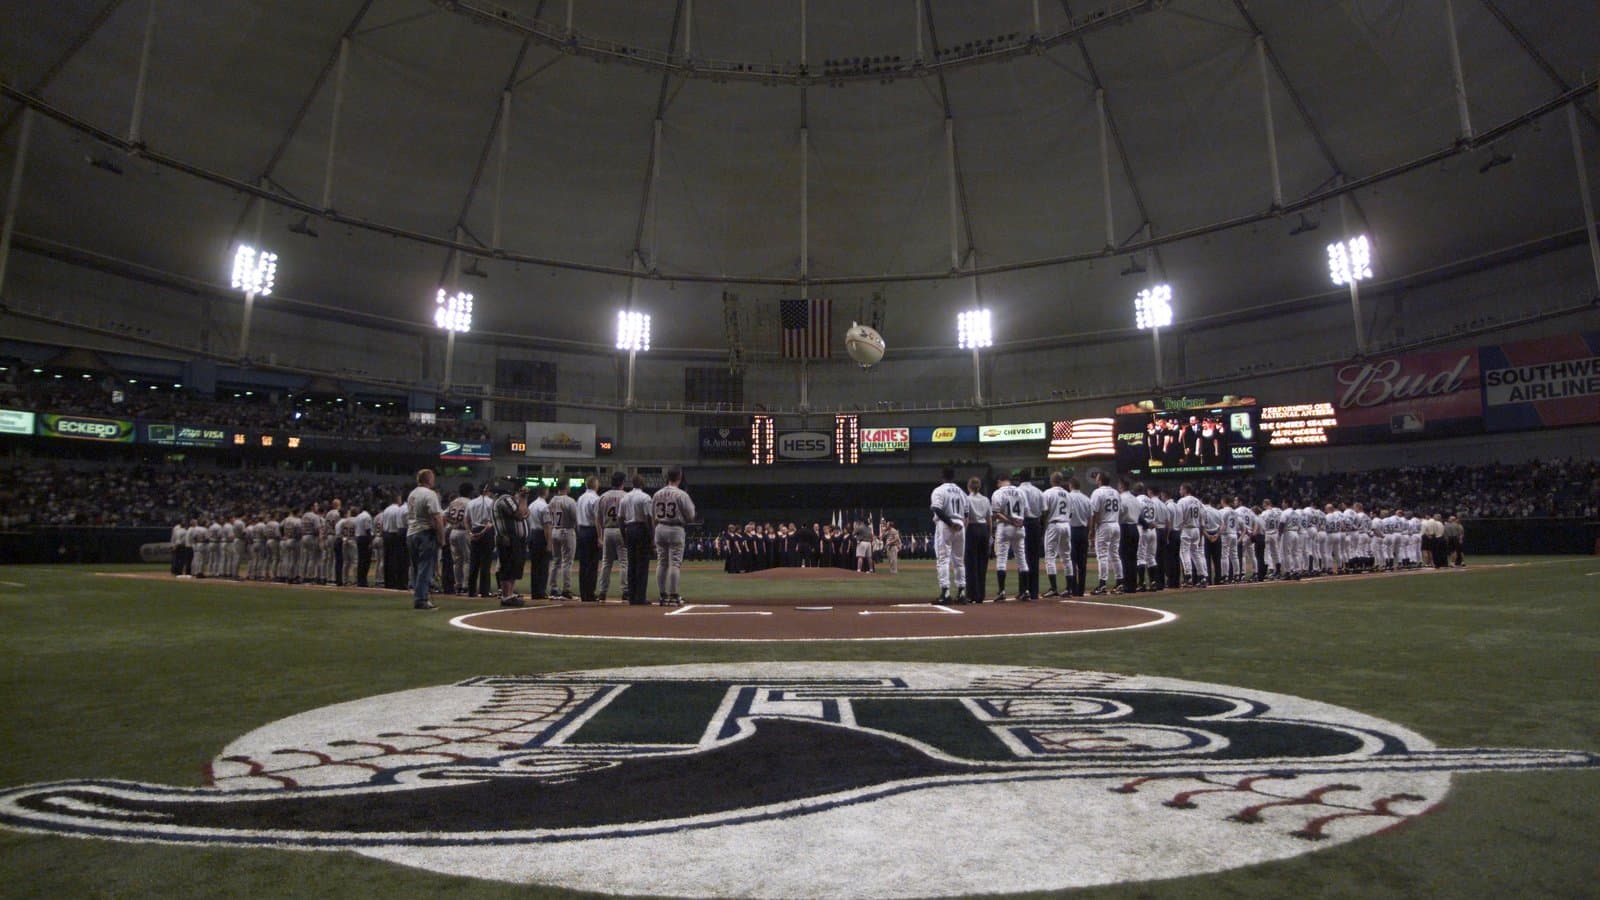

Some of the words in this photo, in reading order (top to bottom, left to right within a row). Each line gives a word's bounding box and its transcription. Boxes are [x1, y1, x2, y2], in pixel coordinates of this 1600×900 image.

[1338, 356, 1469, 409] Bud
[57, 419, 119, 437] ECKERD
[1004, 424, 1042, 436] CHEVROLET
[861, 429, 908, 442] KANE'S
[1117, 432, 1144, 442] PEPSI
[783, 439, 825, 452] HESS
[861, 441, 908, 449] FURNITURE
[656, 502, 676, 519] 33
[951, 498, 960, 513] 11
[1006, 501, 1020, 516] 14
[1058, 501, 1067, 515] 2
[1104, 498, 1119, 513] 28
[449, 509, 464, 521] 26
[607, 506, 617, 521] 4
[1143, 506, 1155, 519] 23
[1190, 506, 1199, 519] 18
